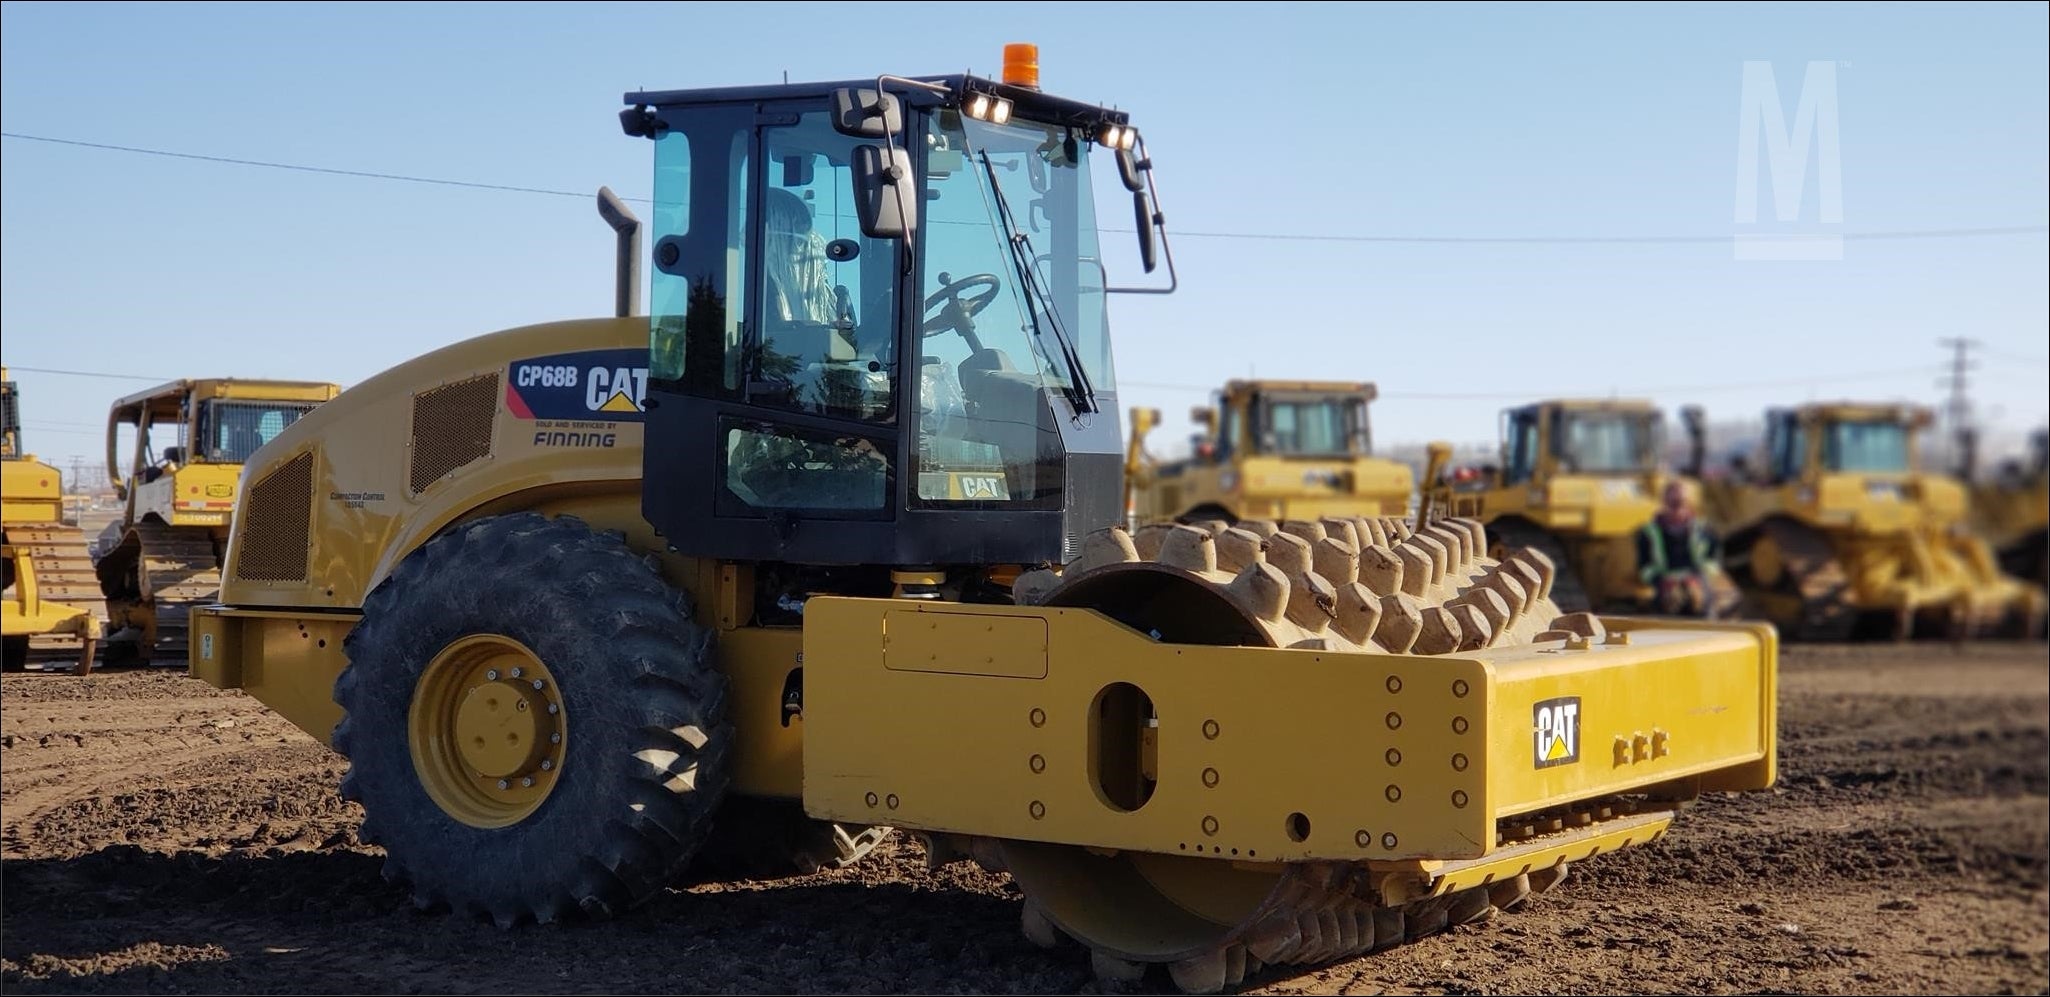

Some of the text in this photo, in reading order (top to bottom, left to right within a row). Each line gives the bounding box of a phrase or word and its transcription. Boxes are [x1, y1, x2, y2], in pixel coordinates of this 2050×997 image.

[518, 365, 578, 387] CP68B
[586, 366, 649, 412] CAT
[533, 431, 616, 448] FINNING
[962, 477, 998, 498] CAT
[1538, 704, 1577, 762] CAT
